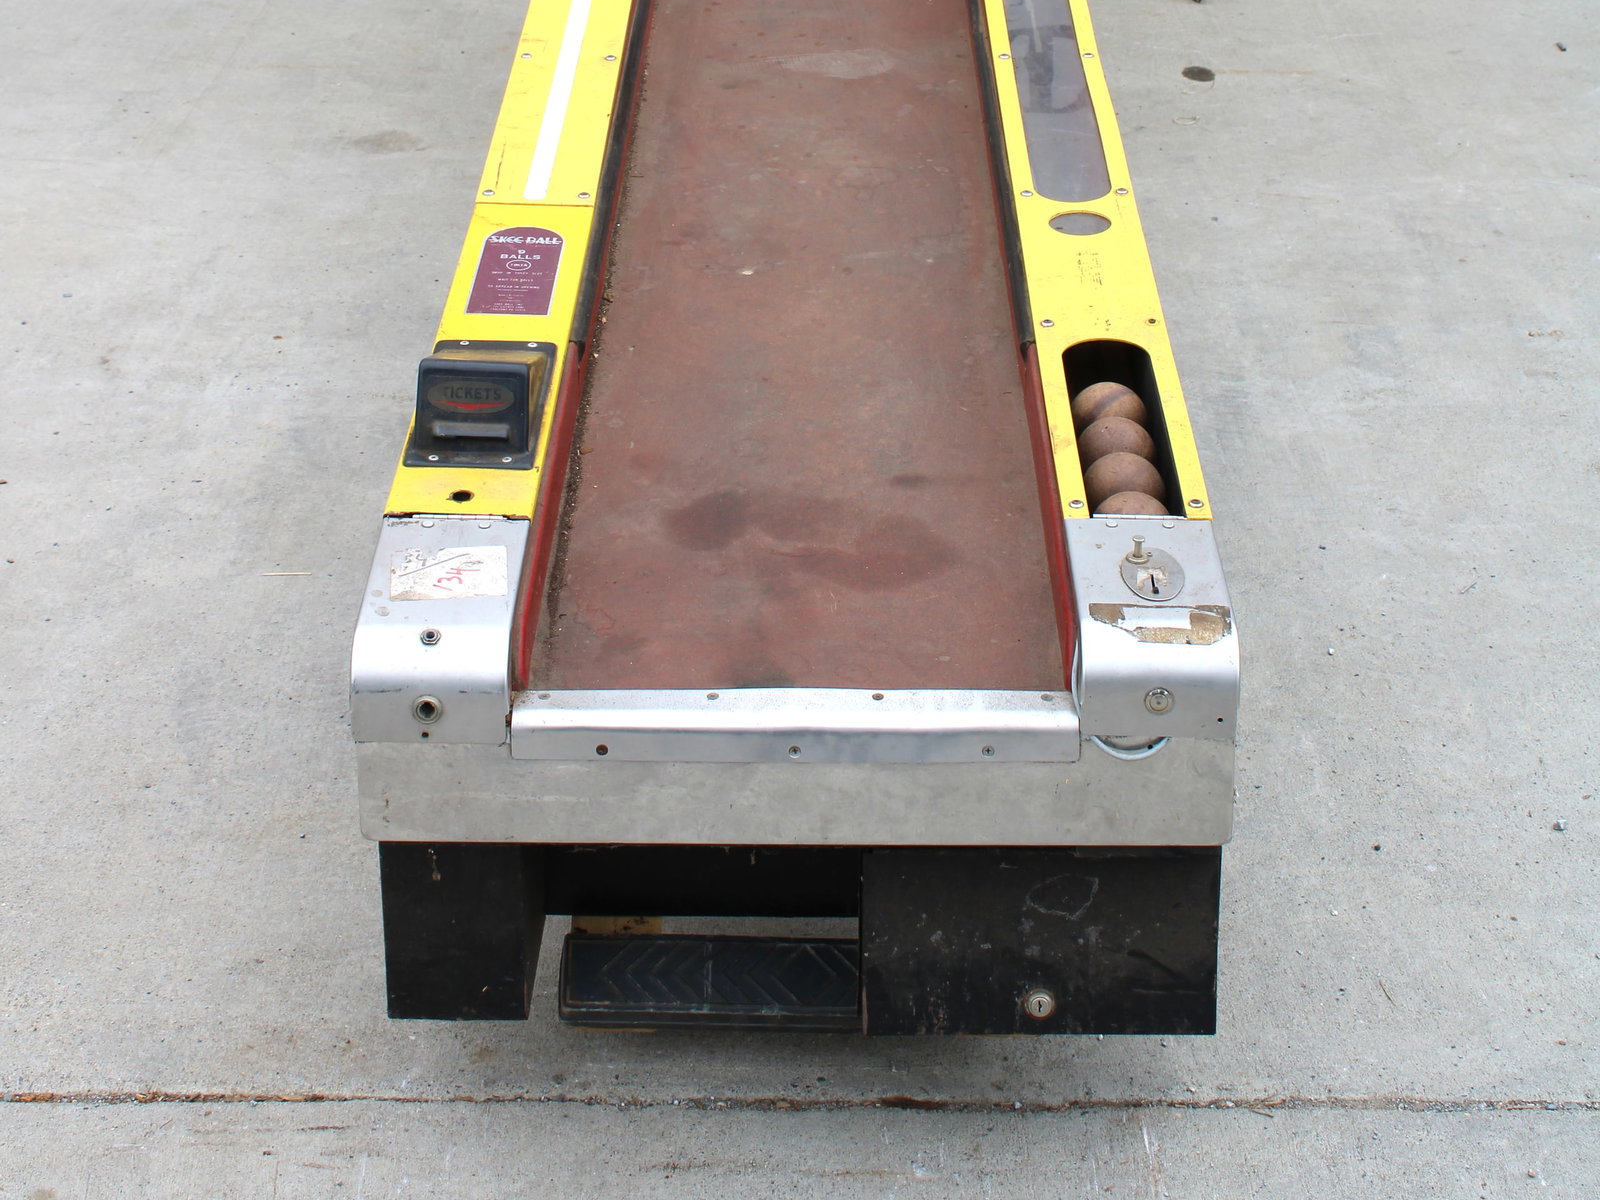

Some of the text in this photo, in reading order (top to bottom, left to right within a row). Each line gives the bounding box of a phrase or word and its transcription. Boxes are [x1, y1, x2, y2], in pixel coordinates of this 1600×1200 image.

[488, 235, 562, 245] SKEE BALL
[442, 386, 502, 400] TICKETS
